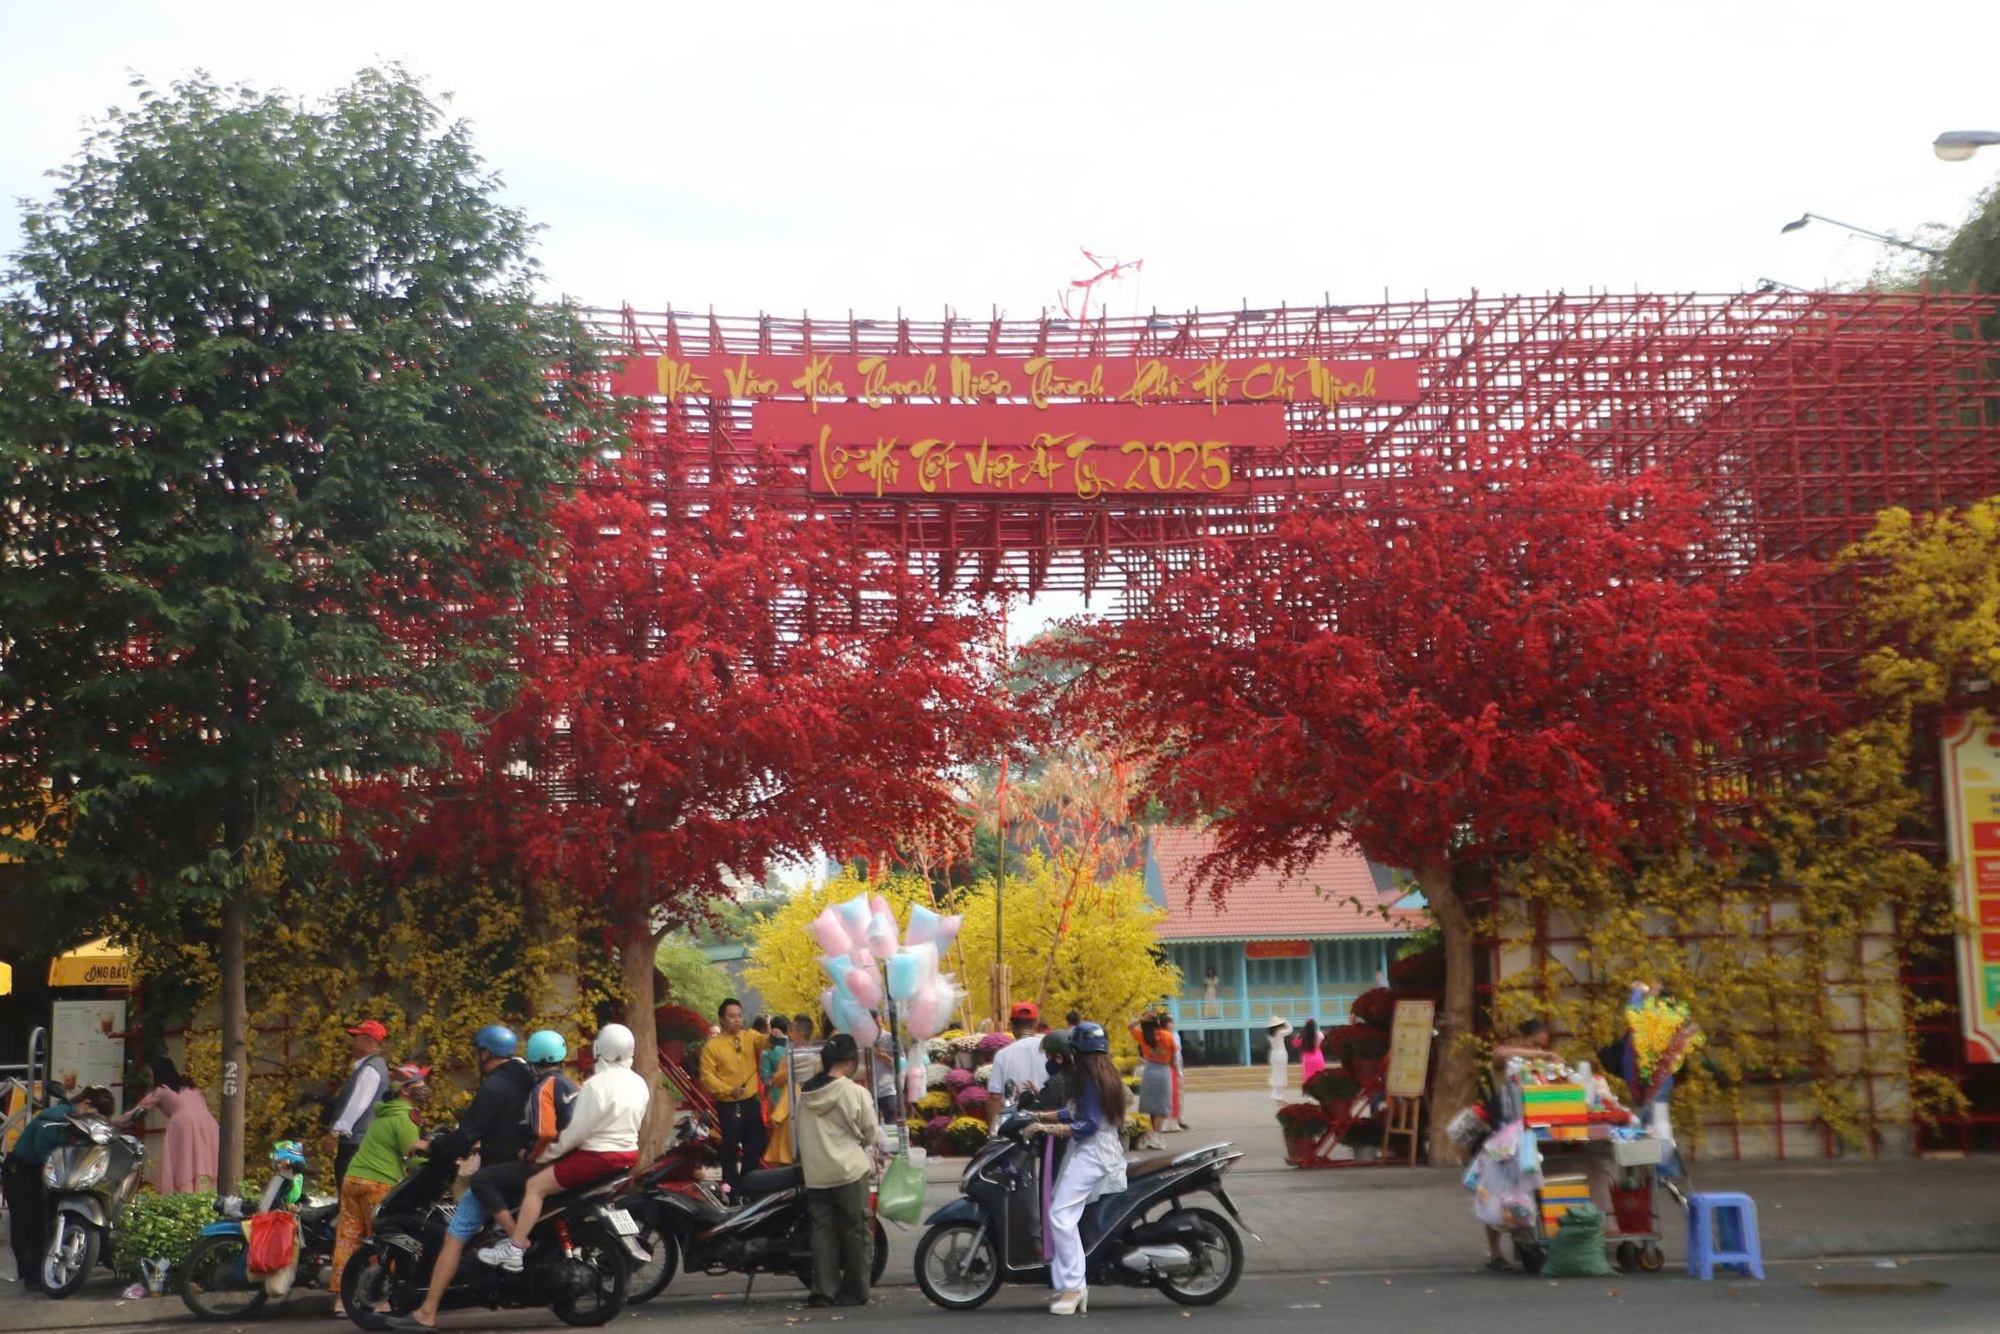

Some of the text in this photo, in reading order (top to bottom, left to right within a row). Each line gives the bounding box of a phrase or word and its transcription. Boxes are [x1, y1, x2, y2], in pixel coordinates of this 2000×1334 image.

[656, 354, 713, 403] Nhà
[723, 354, 779, 399] Văn
[792, 353, 845, 415] Hóa
[857, 355, 938, 409] Thanh
[950, 355, 1012, 402] Niên
[1023, 356, 1104, 410] Thành
[1306, 355, 1376, 412] Minh
[909, 438, 962, 493] Tết
[965, 436, 1026, 490] Việt
[1120, 440, 1232, 491] 2025
